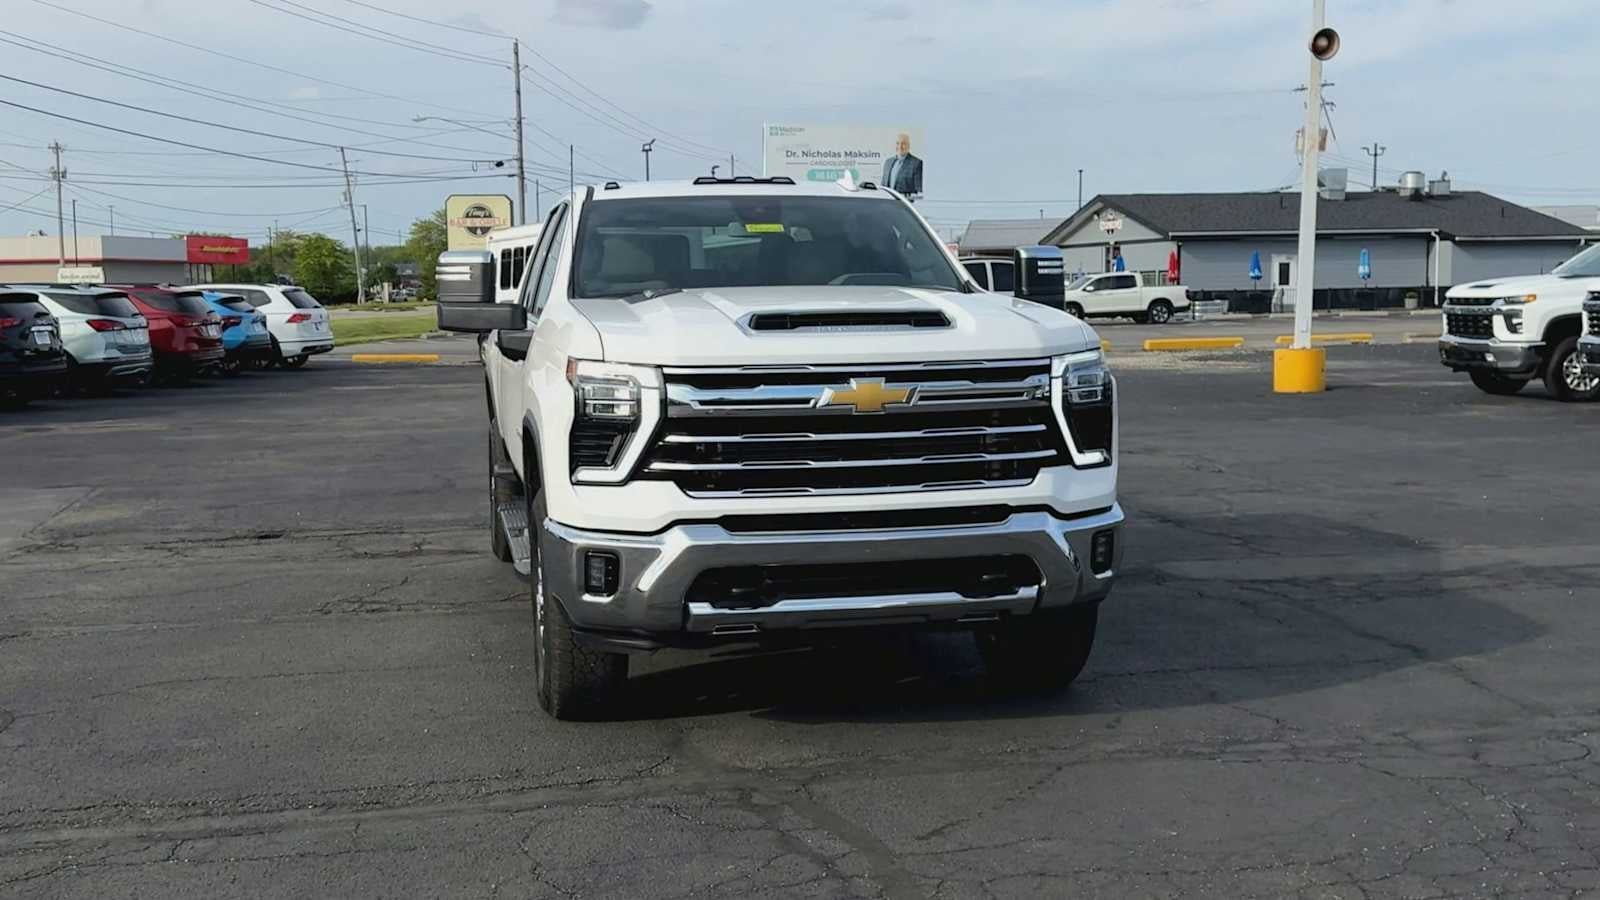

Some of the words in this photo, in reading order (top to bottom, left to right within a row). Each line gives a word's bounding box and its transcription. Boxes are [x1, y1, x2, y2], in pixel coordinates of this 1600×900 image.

[785, 150, 800, 158] Dr.
[801, 150, 842, 158] Nicholas
[844, 150, 881, 158] Maksim
